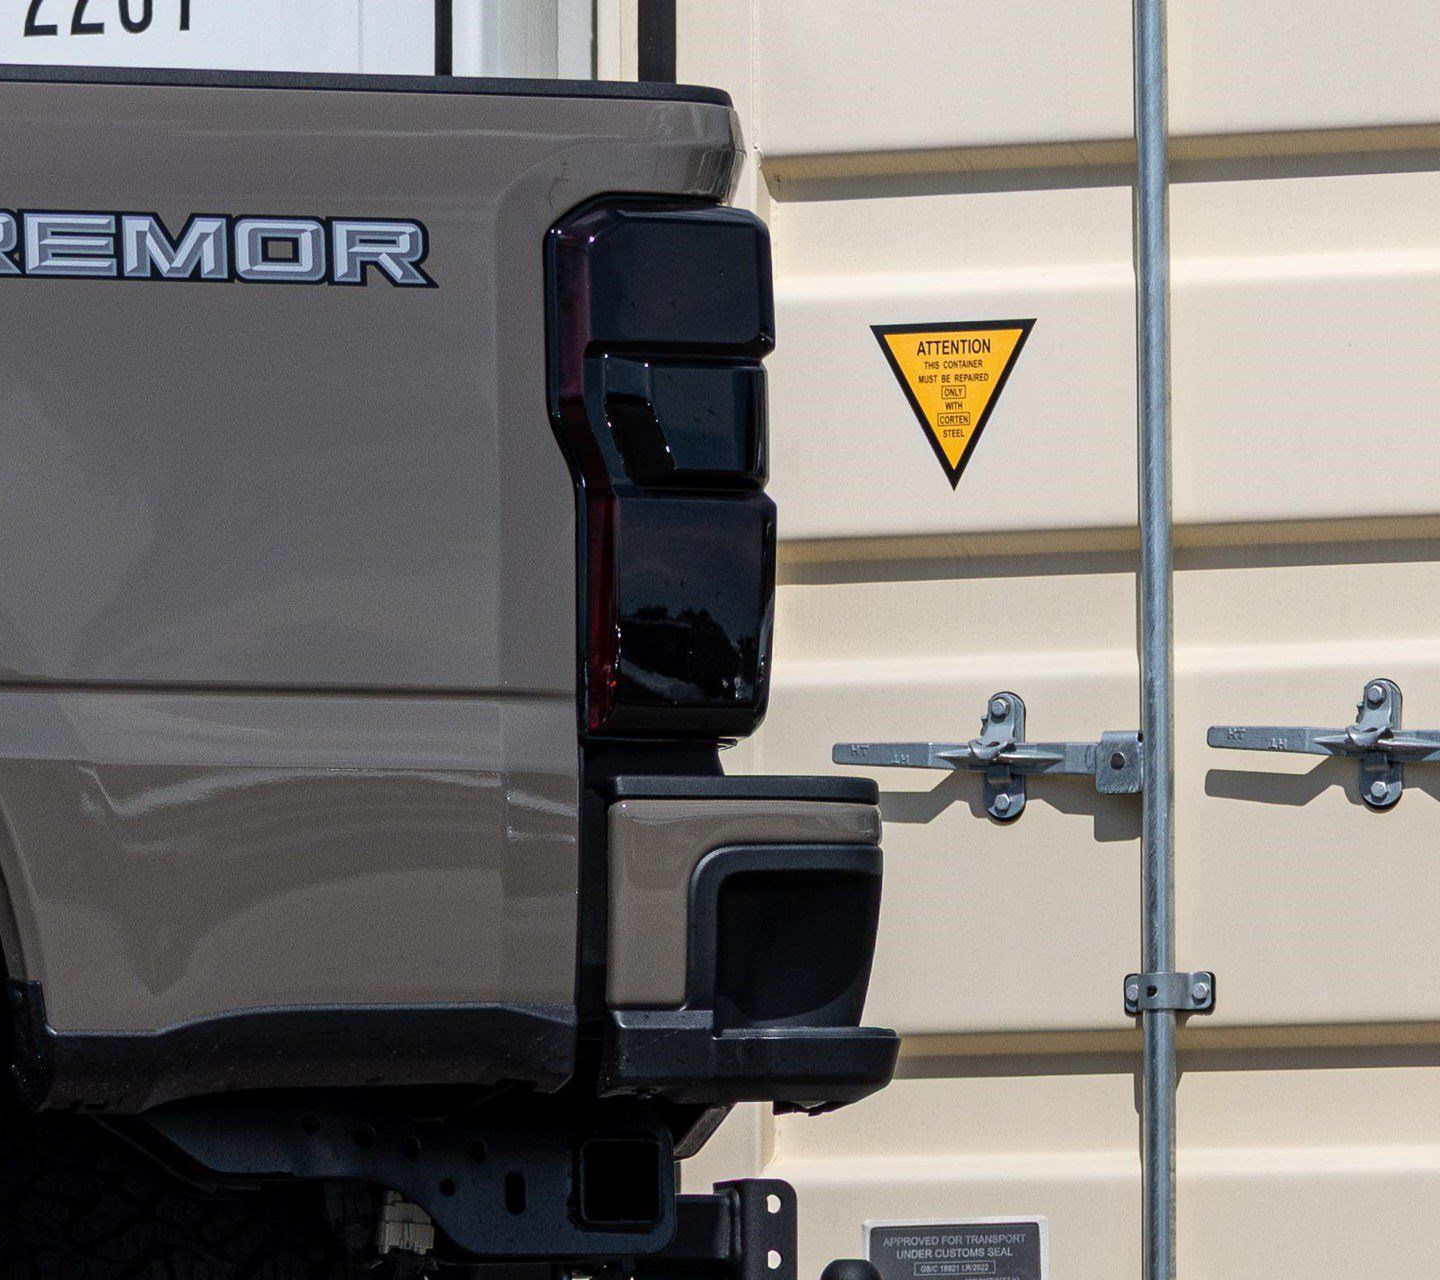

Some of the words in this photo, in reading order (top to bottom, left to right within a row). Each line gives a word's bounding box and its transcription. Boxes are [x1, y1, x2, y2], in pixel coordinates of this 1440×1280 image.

[917, 338, 991, 356] ATTENTION
[924, 360, 940, 370] THIS
[943, 359, 983, 369] CONTAINER
[918, 374, 938, 384] MUST
[941, 374, 951, 383] BE
[954, 372, 989, 383] REPAIRED
[944, 387, 963, 397] ONLY
[945, 401, 963, 411] WITH
[939, 415, 969, 425] CORTEN
[943, 429, 965, 438] STEEL
[883, 1235, 939, 1247] APPROVED
[941, 1235, 963, 1245] FOR
[965, 1233, 1026, 1245] TRANSPORT
[896, 1249, 933, 1260] UNDER
[935, 1248, 986, 1258] CUSTOMS
[987, 1246, 1013, 1257] SEAL
